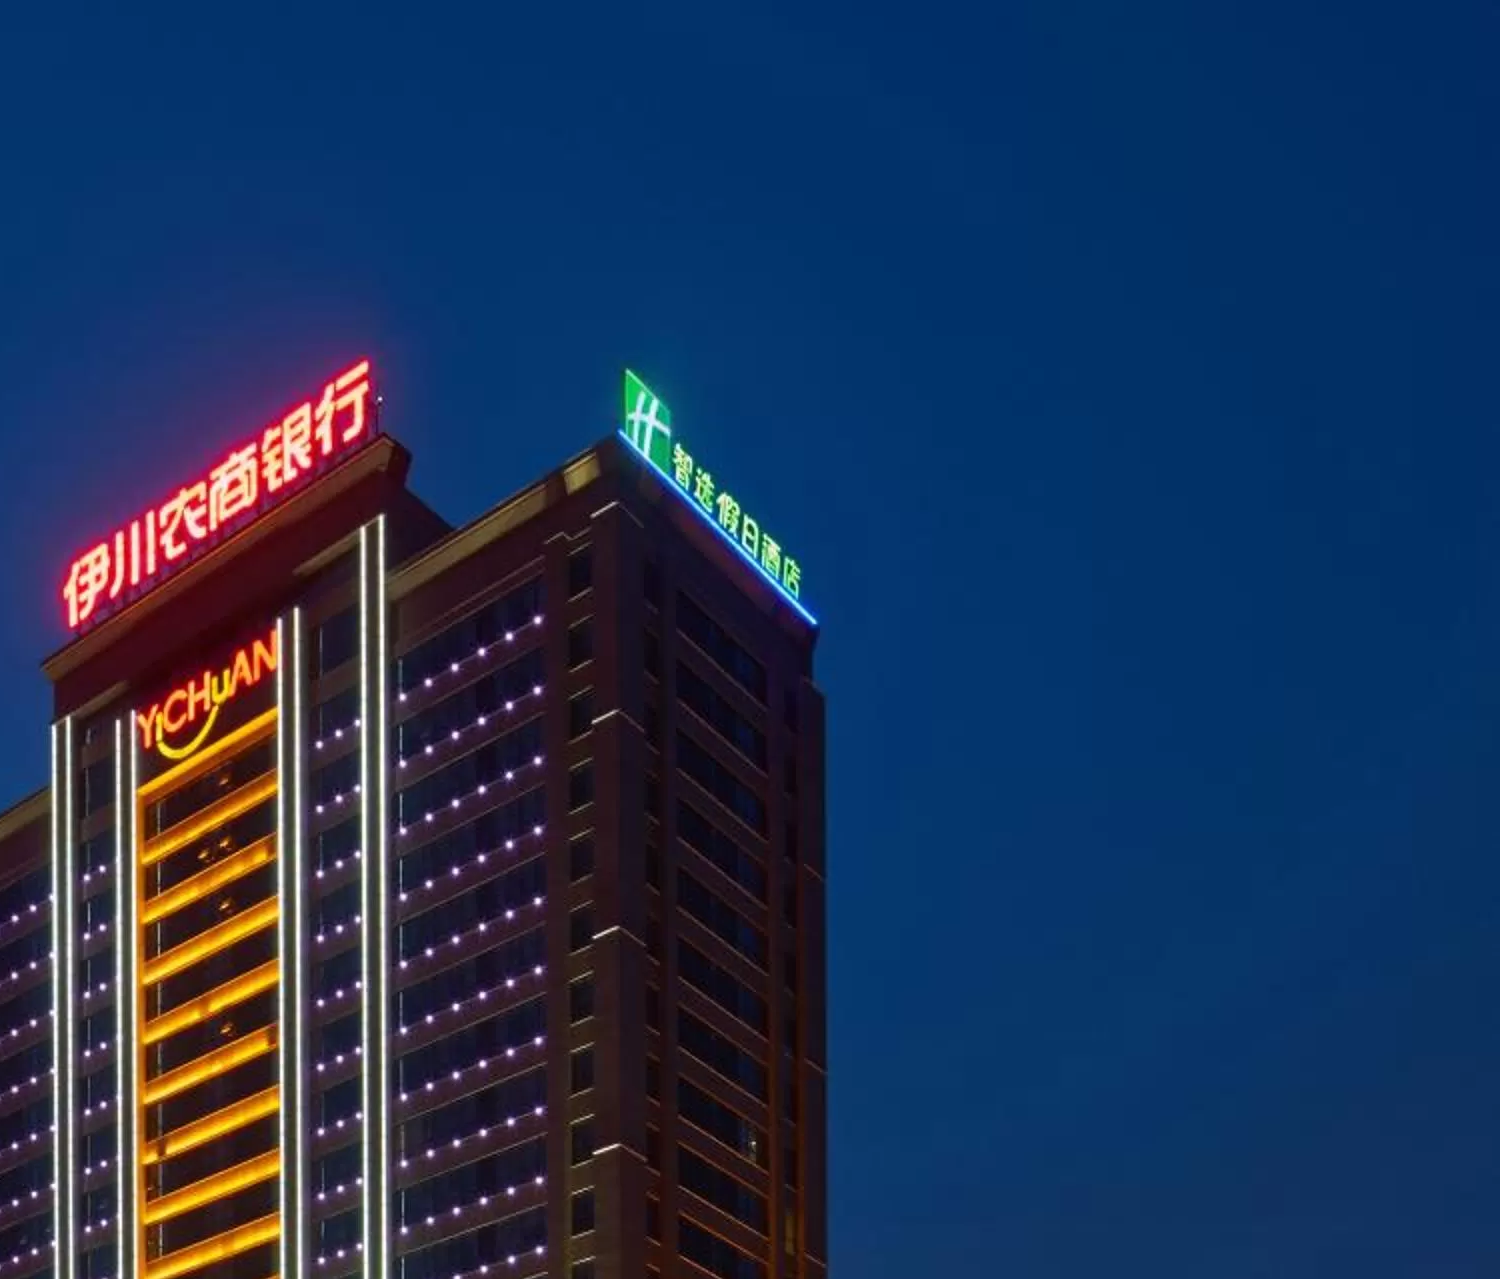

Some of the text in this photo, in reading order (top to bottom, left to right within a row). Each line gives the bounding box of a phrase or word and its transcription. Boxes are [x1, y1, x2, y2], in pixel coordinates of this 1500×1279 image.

[63, 360, 370, 628] 伊川农商银行
[672, 443, 801, 600] 智选假日酒店
